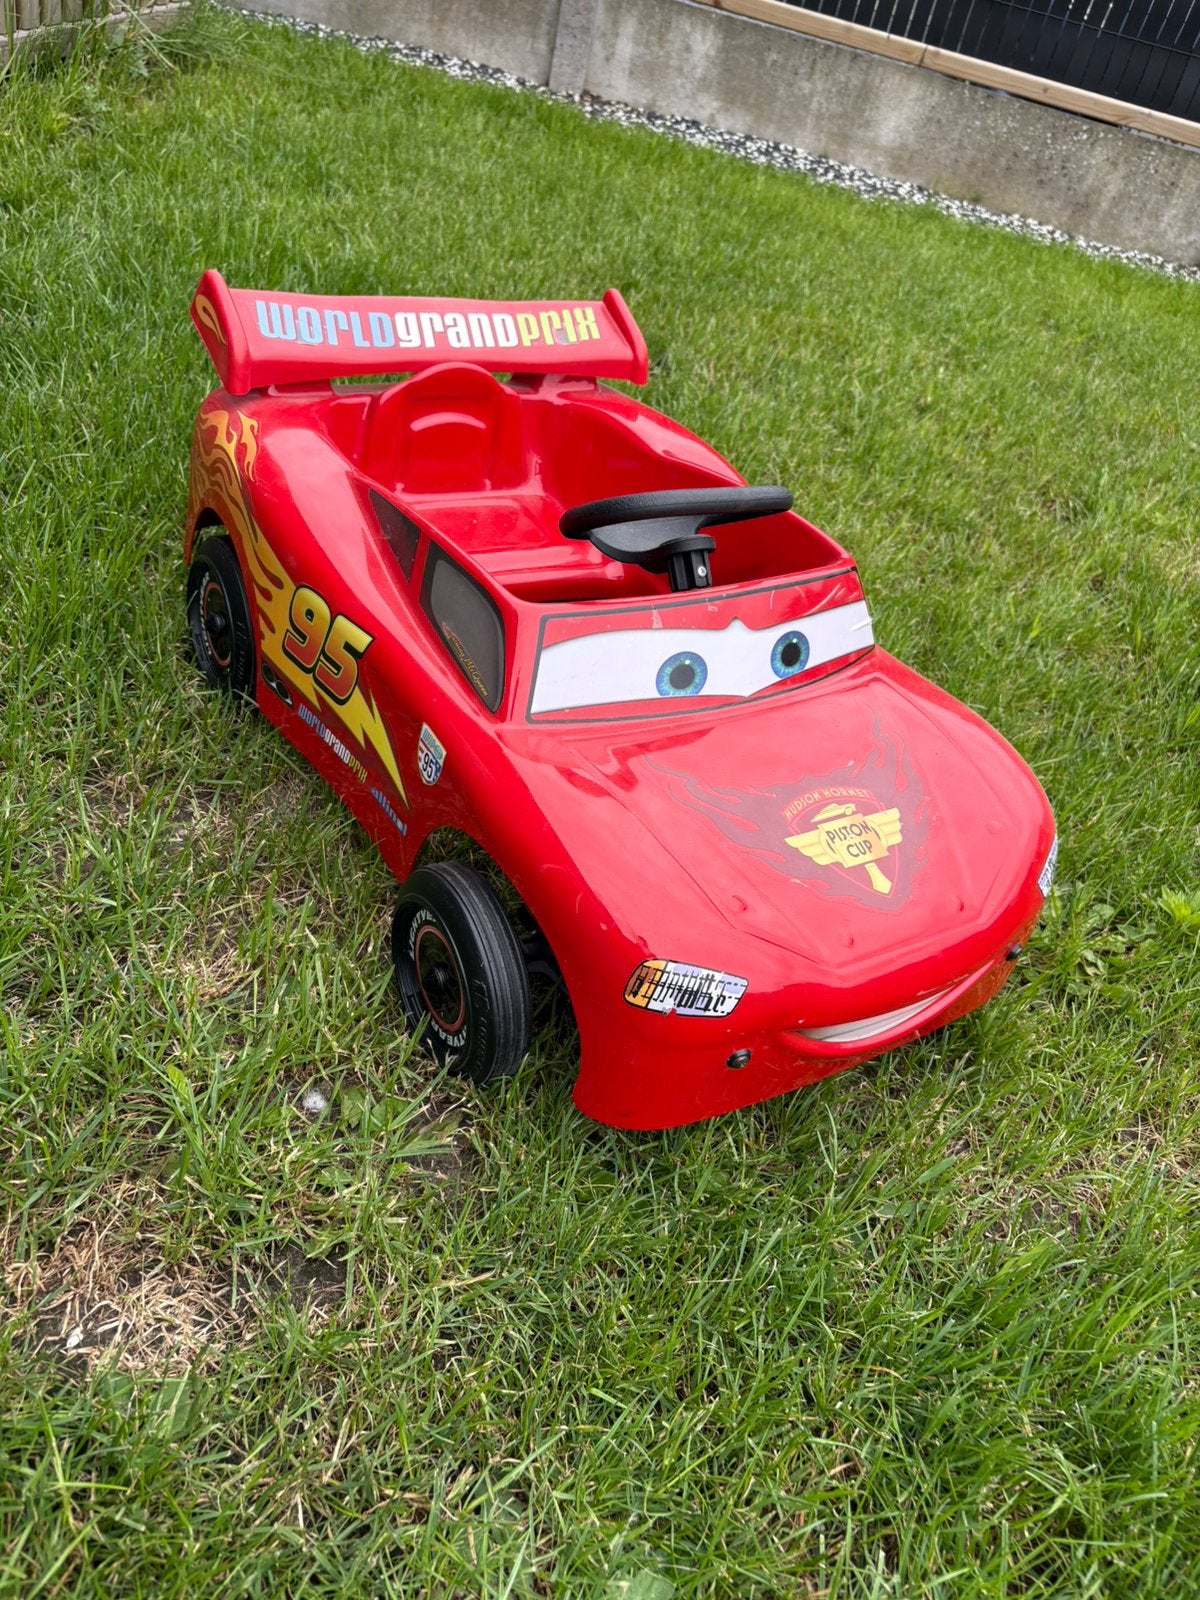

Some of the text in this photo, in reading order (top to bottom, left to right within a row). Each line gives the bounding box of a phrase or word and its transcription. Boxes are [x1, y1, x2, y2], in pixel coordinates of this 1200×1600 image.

[282, 583, 375, 706] 95
[422, 752, 435, 778] 95
[784, 786, 869, 820] HUDSON HORNET
[826, 820, 872, 844] PISTON
[846, 839, 873, 858] CUP
